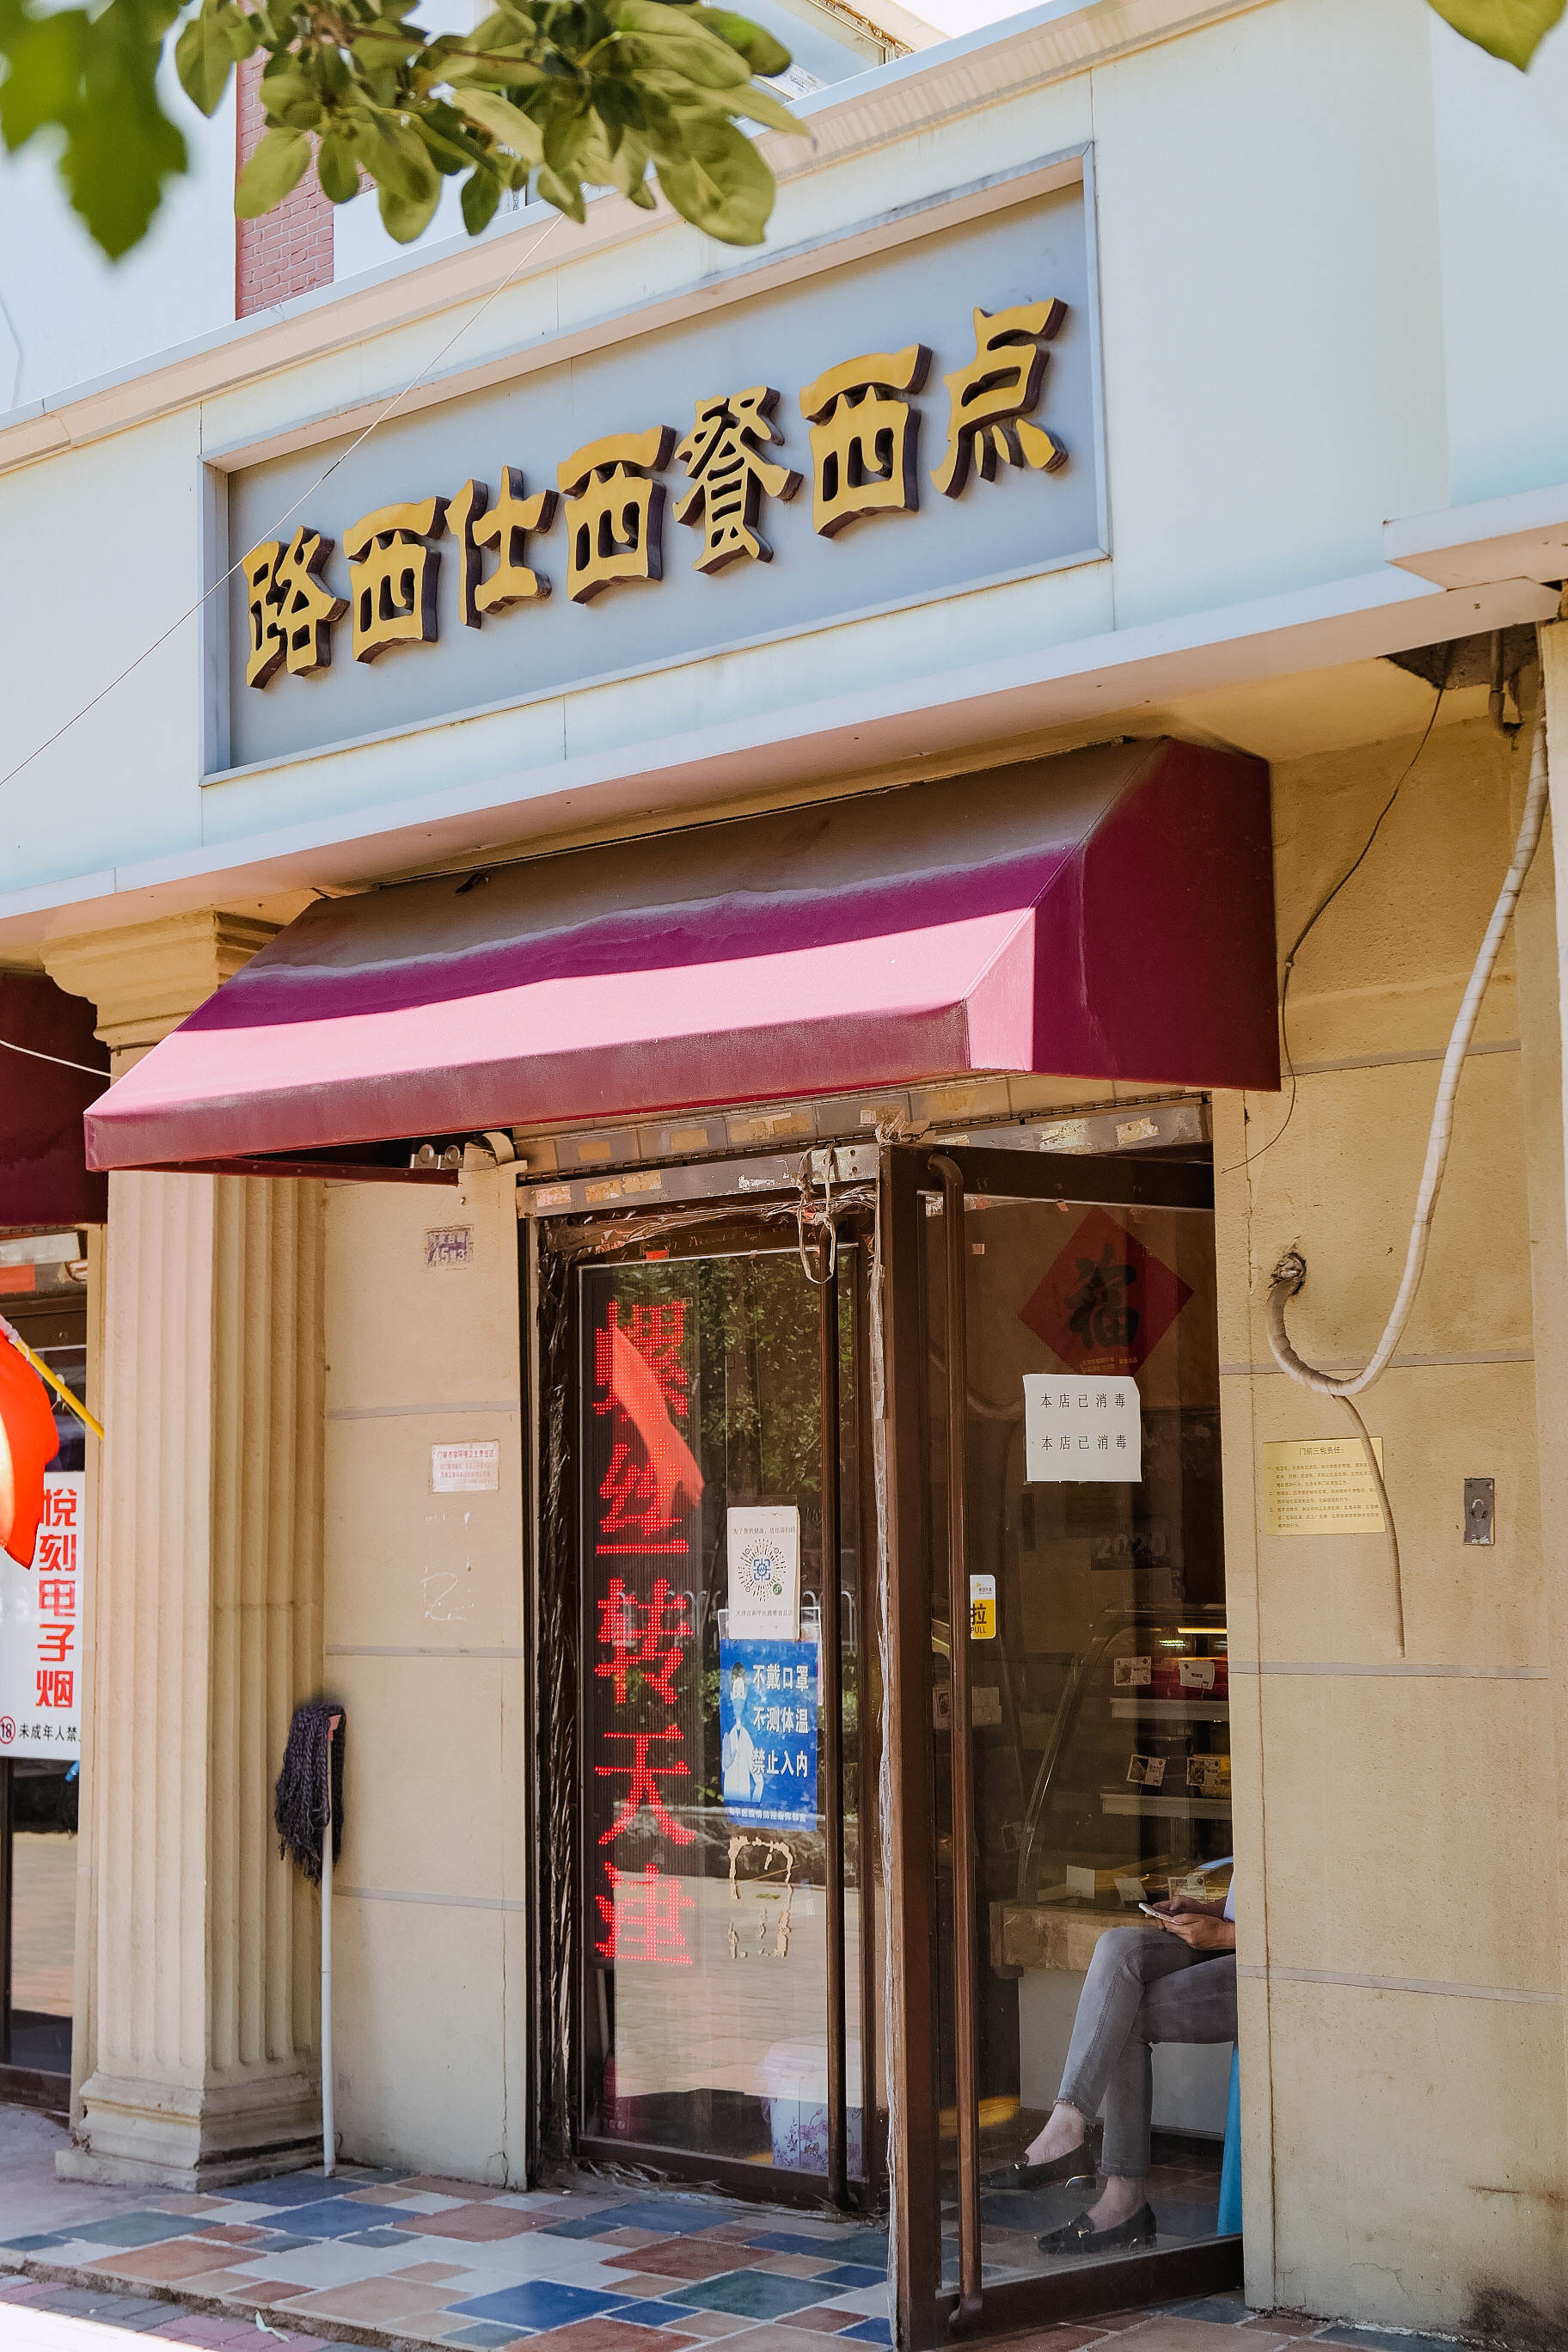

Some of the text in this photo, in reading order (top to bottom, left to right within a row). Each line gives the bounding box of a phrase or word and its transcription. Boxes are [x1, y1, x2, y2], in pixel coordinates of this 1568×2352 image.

[241, 296, 1069, 689] 路西仕西餐西点
[1064, 1243, 1140, 1350] 福
[1040, 1392, 1125, 1409] 本店已消毒
[1041, 1435, 1127, 1451] 本店已消毒
[35, 1488, 77, 1708] 悦刻电子烟
[971, 1603, 987, 1625] 拉
[752, 1663, 809, 1692] 不戴口罩
[19, 1721, 81, 1743] 未成年人禁
[752, 1706, 809, 1734] 不测体温
[751, 1748, 808, 1778] 禁止入内
